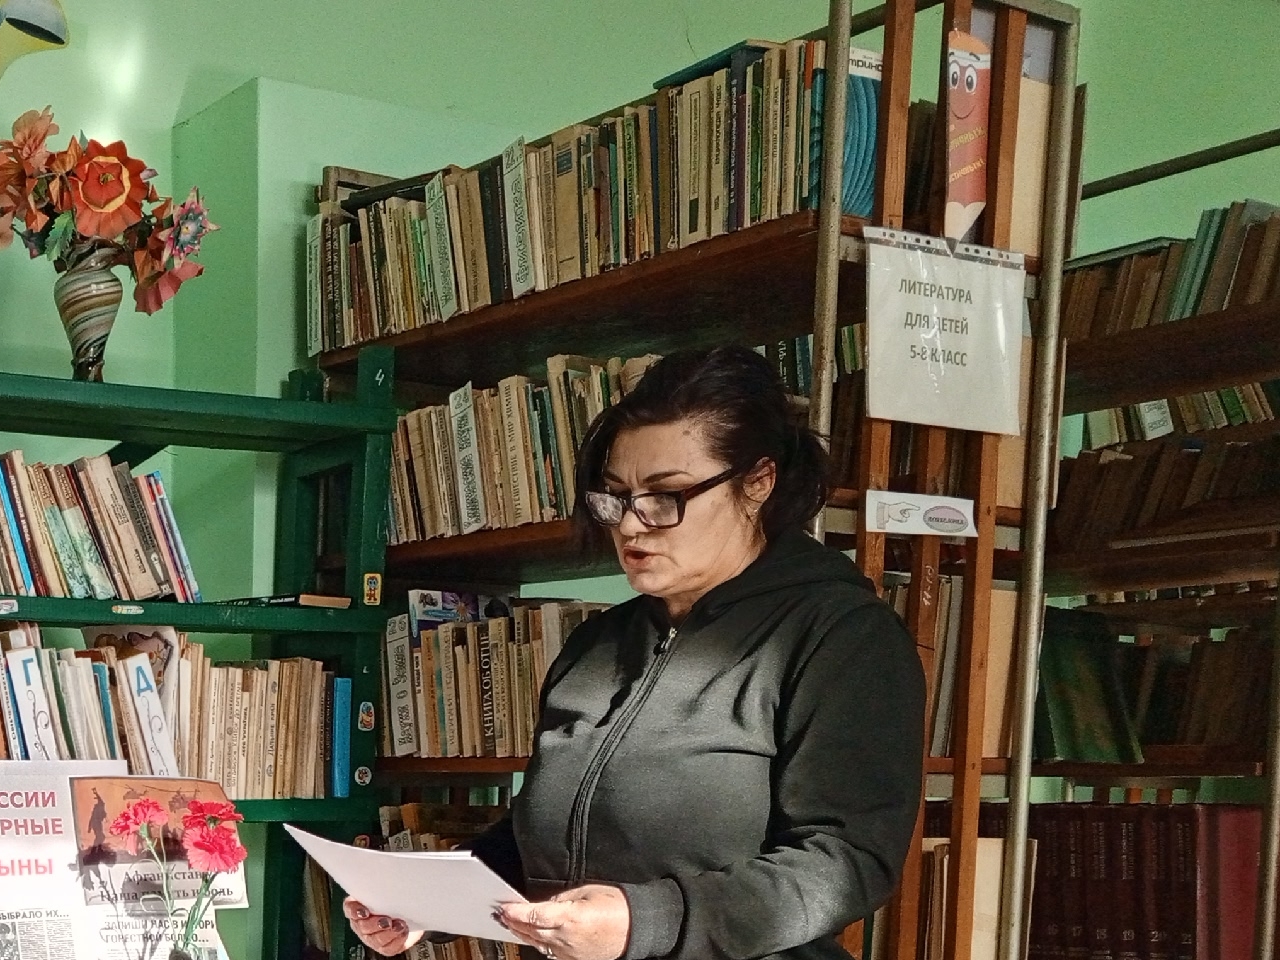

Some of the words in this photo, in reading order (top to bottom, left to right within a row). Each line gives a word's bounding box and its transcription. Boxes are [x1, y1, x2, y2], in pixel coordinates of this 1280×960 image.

[899, 279, 973, 304] ЛИТЕРАТУРА
[904, 312, 930, 329] ДЛЯ
[936, 315, 969, 335] ДЕТЕЙ
[910, 345, 928, 361] 5-8
[479, 631, 490, 668] ОТЦЕ
[23, 658, 39, 687] Г
[135, 665, 155, 695] Д
[481, 670, 491, 689] ОБ
[482, 691, 494, 736] КНИГА
